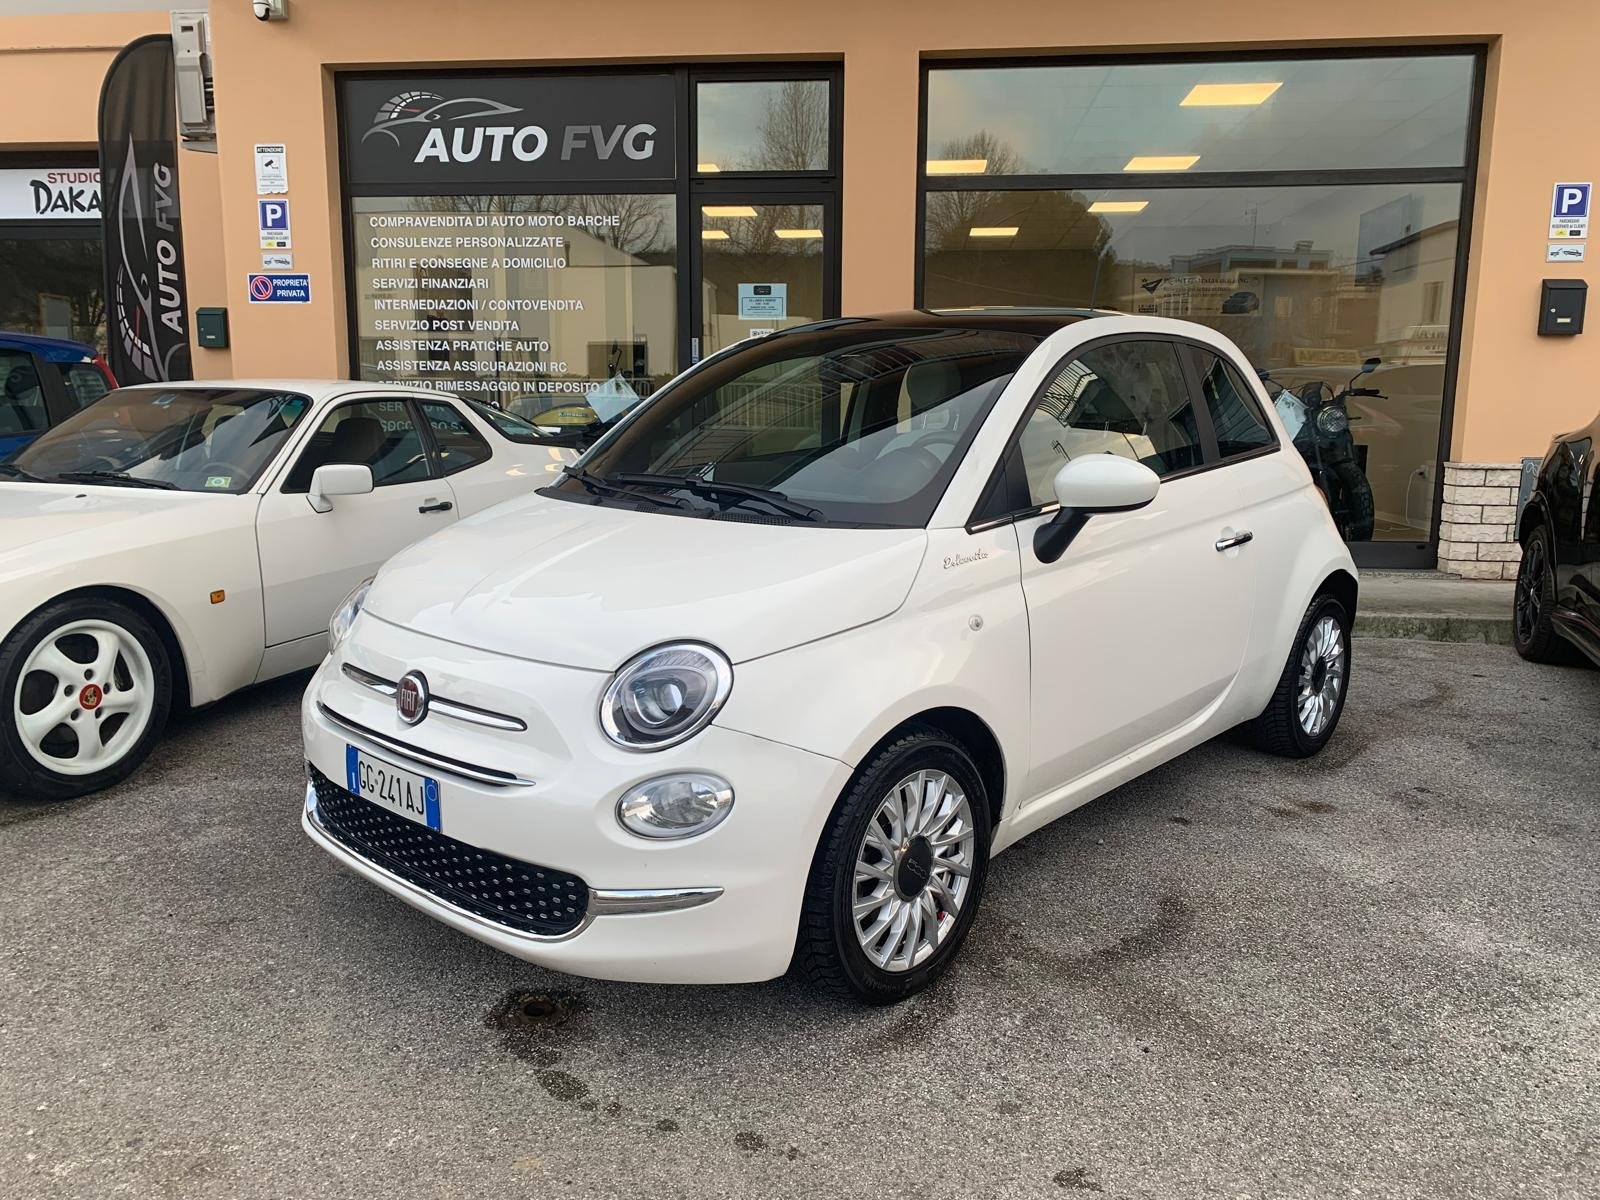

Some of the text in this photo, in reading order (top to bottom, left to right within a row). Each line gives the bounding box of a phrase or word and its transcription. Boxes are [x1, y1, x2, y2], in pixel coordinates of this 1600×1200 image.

[413, 123, 657, 163] AUTO FVG
[1561, 188, 1583, 214] P
[265, 204, 282, 227] P
[369, 215, 620, 227] COMPRAVENDITA DI AUTO MOTO BARCHE
[153, 162, 184, 334] AUTO FVG
[371, 236, 564, 248] CONSULENZE PERSONALIZZATE
[372, 257, 566, 269] RITIRI E CONSEGNE A DOMICILIO
[372, 278, 489, 289] SERVIZI FINANZIARI
[374, 299, 478, 310] INTERMEDIAZIONI
[488, 299, 584, 311] CONTOVENDITA
[375, 320, 520, 331] SERVIZIO POST VENDITA
[376, 340, 549, 352] ASSISTENZA PRATICHE AUTO
[377, 360, 568, 372] ASSISTENZA ASSICURAZIONI RC
[435, 381, 520, 392] RIMESSAGGIO
[523, 382, 535, 392] IN
[539, 382, 600, 393] DEPOSITO
[400, 689, 417, 711] FIAT
[359, 760, 374, 793] GG
[377, 769, 425, 815] 241AJ
